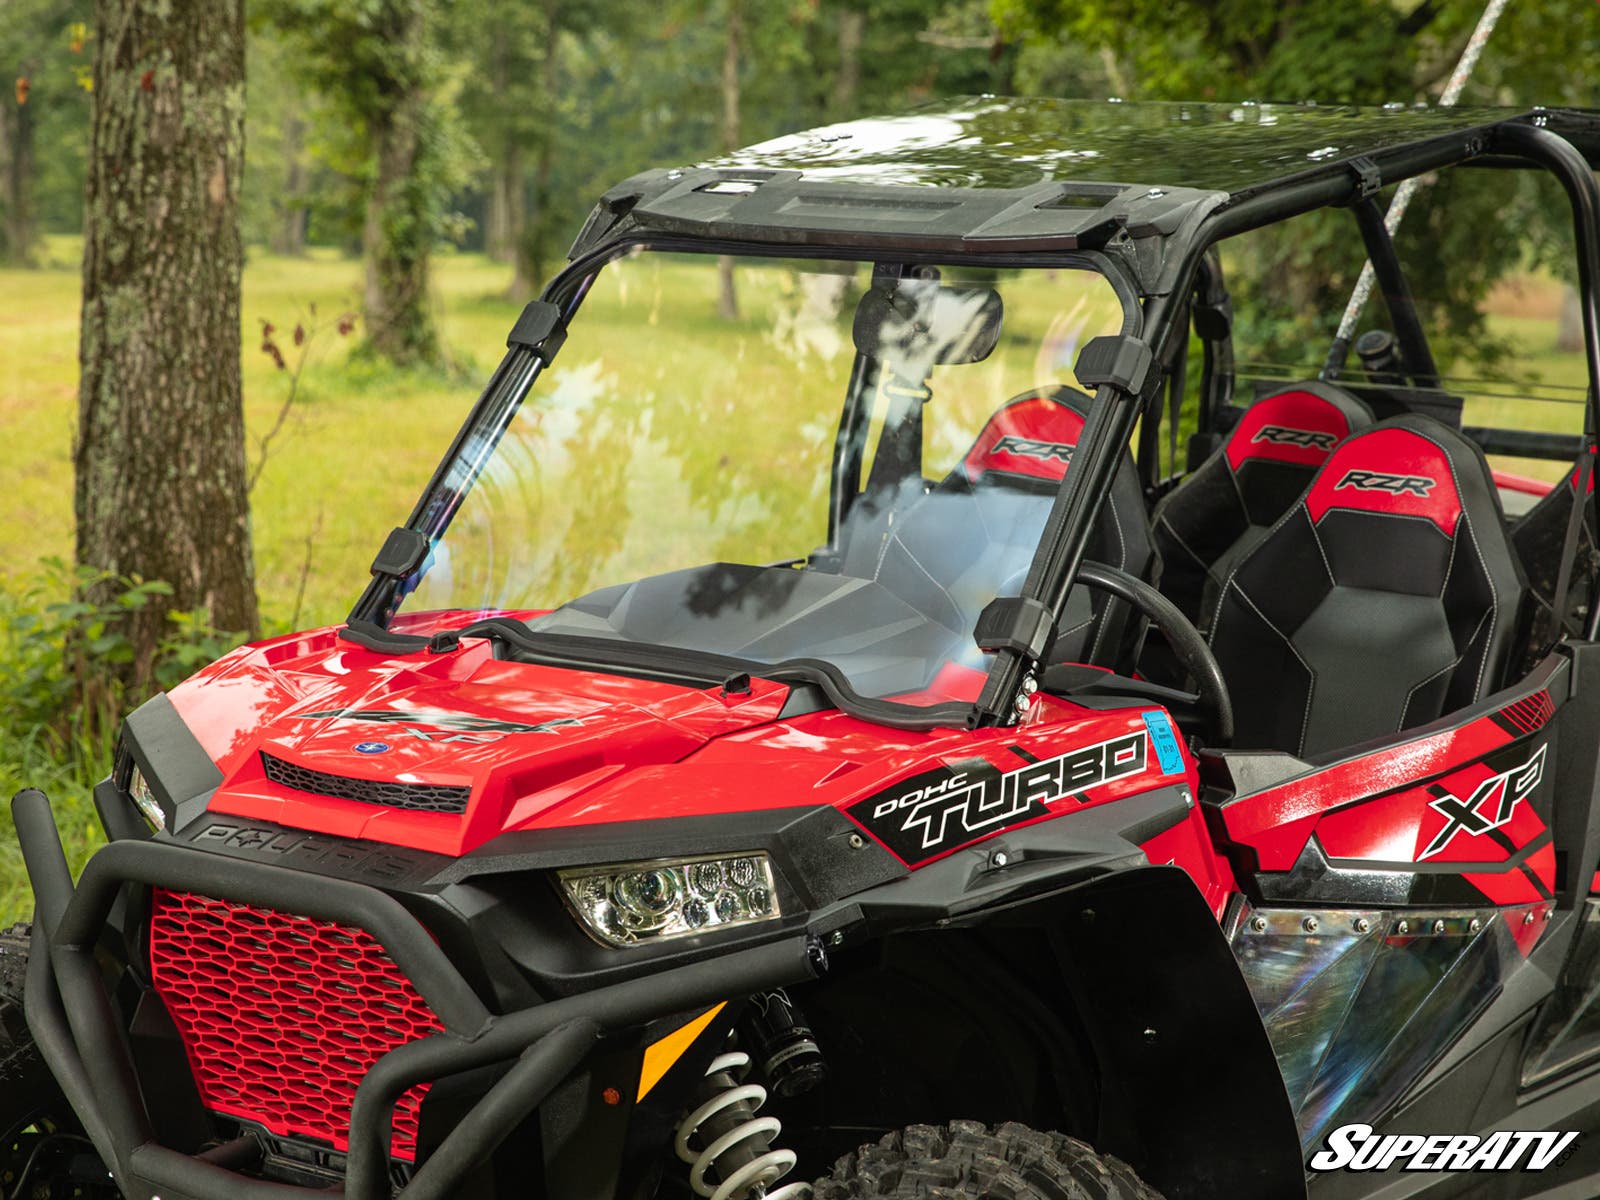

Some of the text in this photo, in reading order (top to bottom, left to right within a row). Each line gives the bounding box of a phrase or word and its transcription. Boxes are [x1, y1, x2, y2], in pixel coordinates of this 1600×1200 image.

[990, 435, 1074, 463] RZR
[1251, 425, 1338, 450] RZR
[1335, 470, 1434, 497] RZR
[873, 772, 969, 819] DOHC
[901, 729, 1148, 850] TURBO
[1416, 742, 1548, 863] XP
